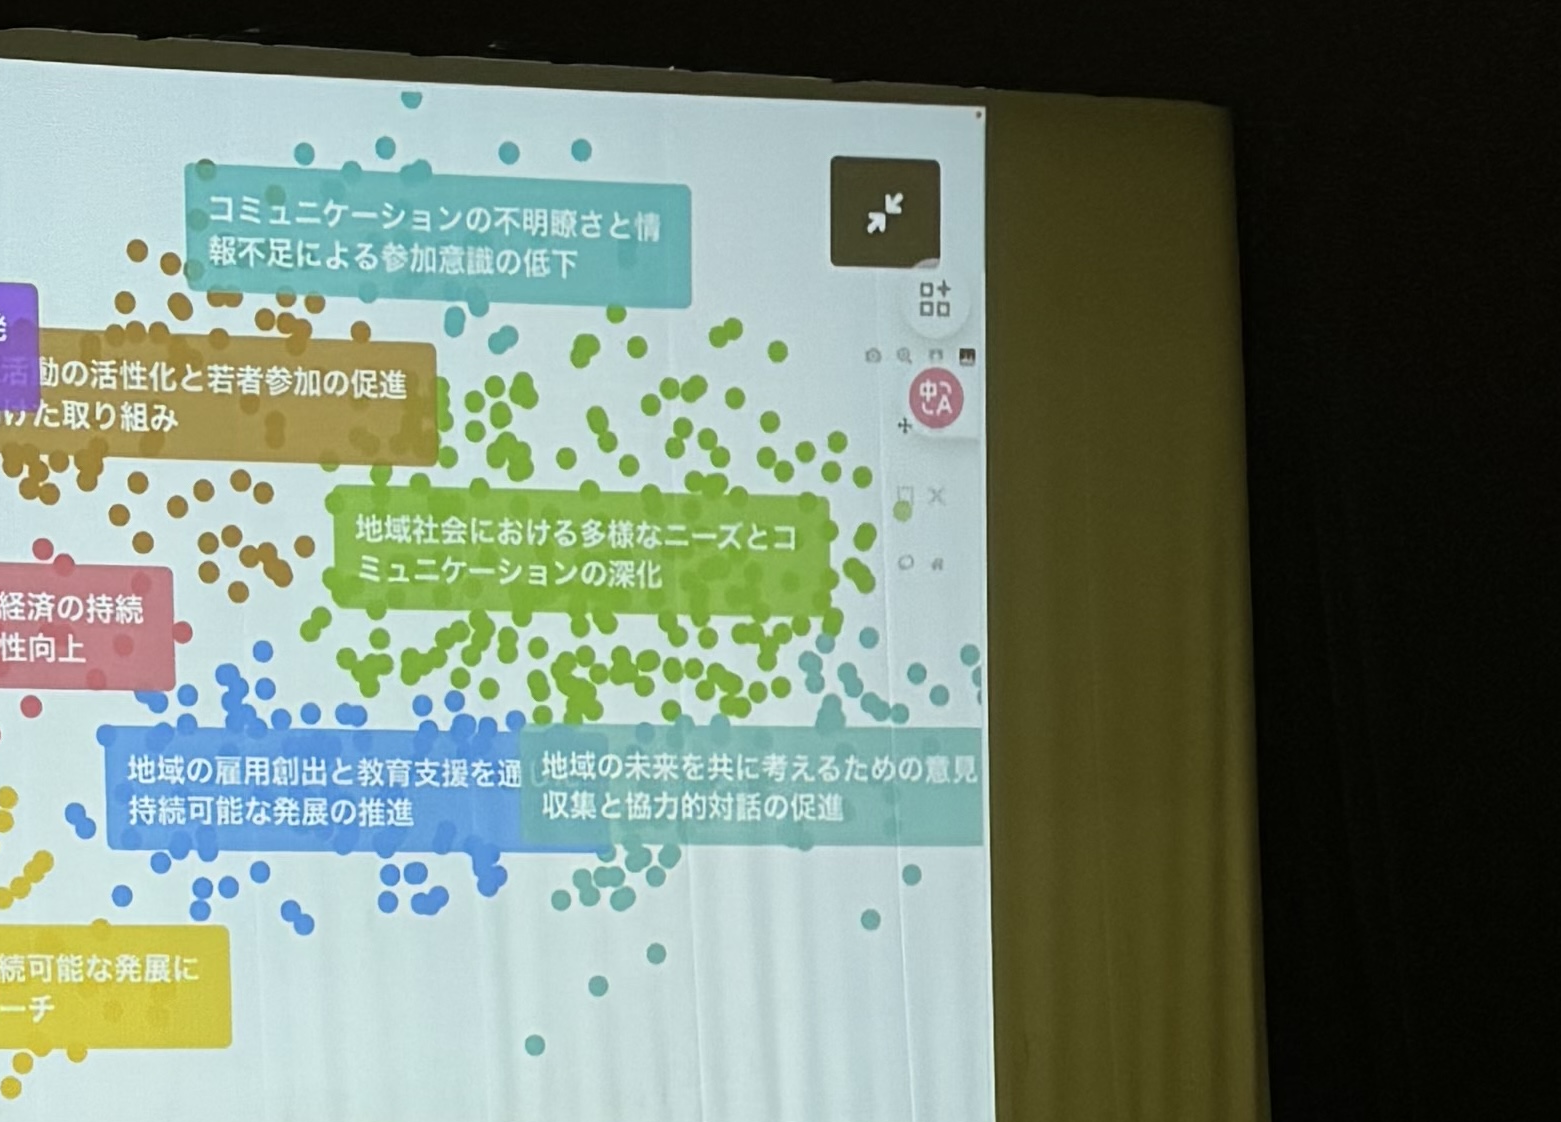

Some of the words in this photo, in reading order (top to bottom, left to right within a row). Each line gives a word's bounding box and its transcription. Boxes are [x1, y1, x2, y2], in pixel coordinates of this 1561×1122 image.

[208, 236, 578, 279] 報不足による参加意識の低下
[355, 514, 795, 551] 地域社会における多様なニーズとコ
[357, 558, 663, 589] ミュニケーションの深化
[542, 750, 978, 784] 地域の未来を共に考えるための意見
[129, 795, 414, 828] 持続可能な発展の推進
[542, 790, 843, 822] 収集と協力的対話の促進
